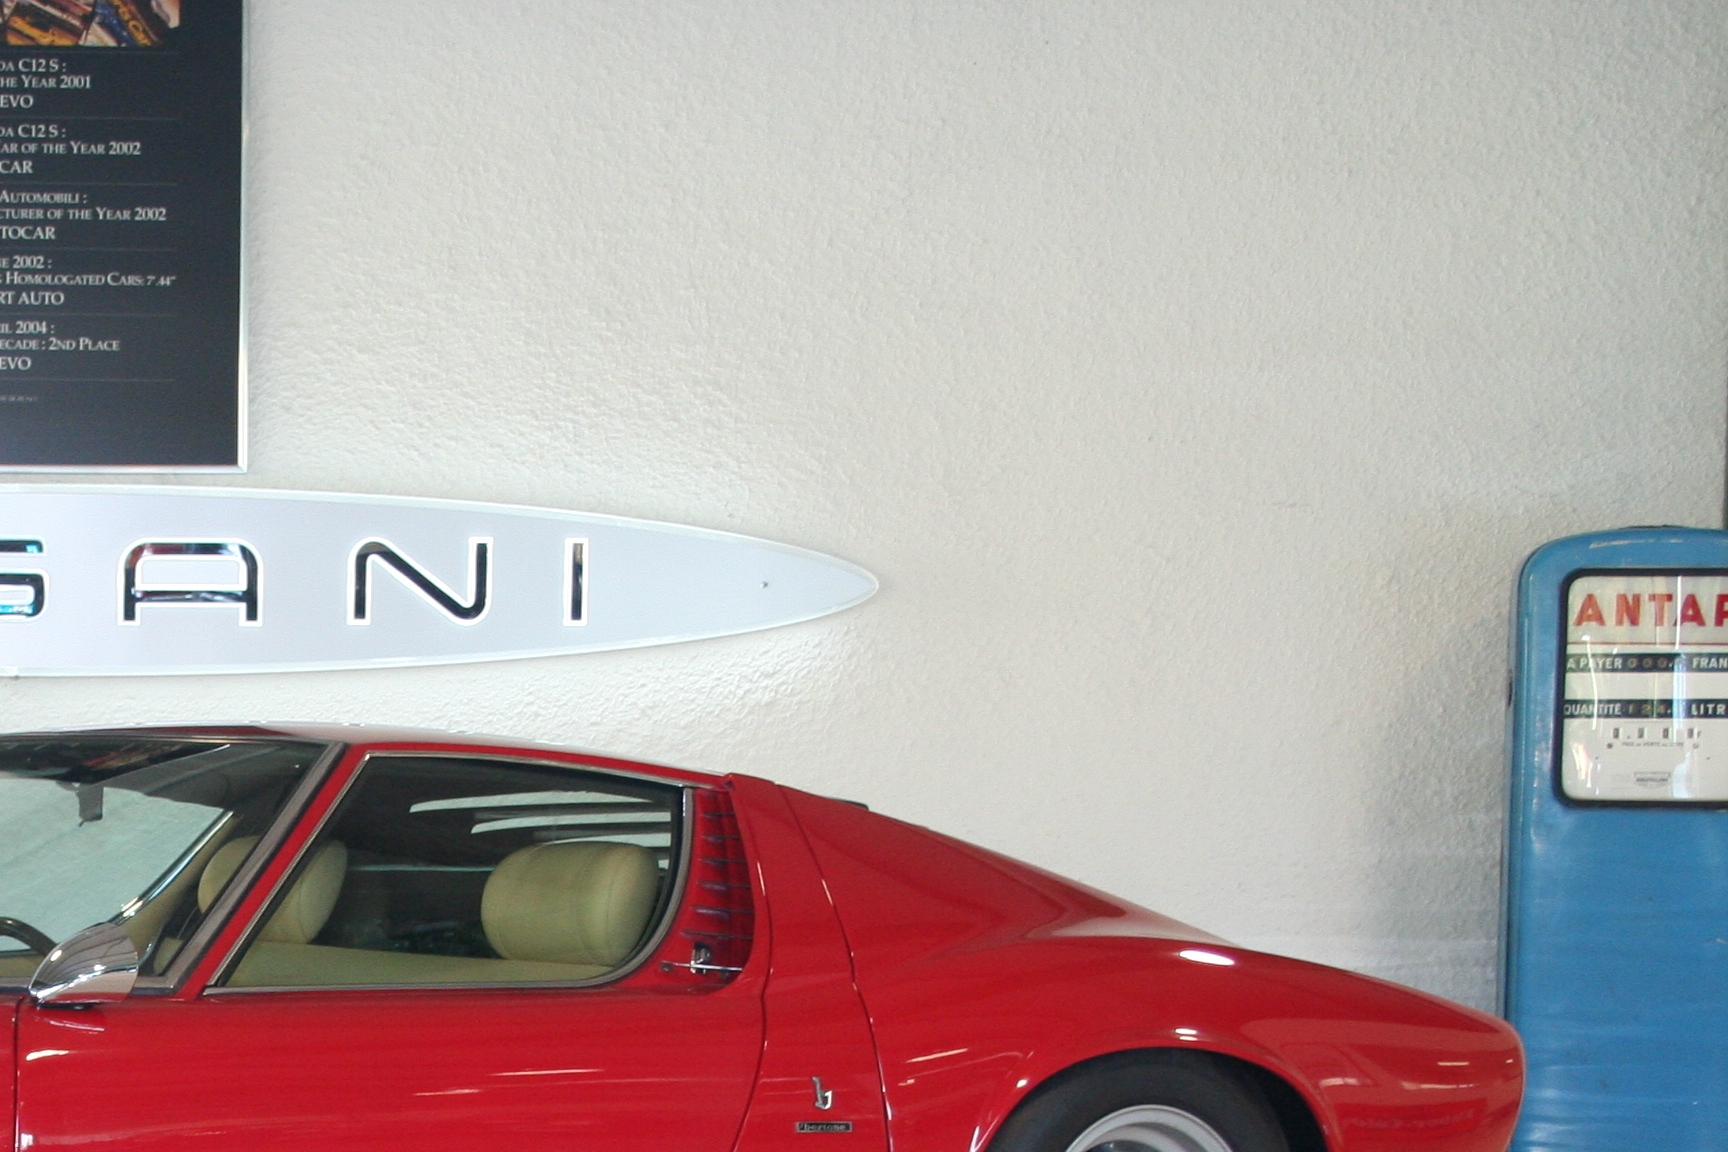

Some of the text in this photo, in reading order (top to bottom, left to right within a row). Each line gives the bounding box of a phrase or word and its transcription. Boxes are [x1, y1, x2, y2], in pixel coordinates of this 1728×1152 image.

[18, 58, 46, 72] C12
[21, 73, 57, 88] YEAR
[59, 74, 91, 89] 2001
[0, 94, 34, 108] EVO
[17, 124, 46, 138] C12
[20, 142, 38, 154] OF
[42, 143, 66, 154] THE
[69, 140, 105, 155] YEAR
[108, 141, 141, 156] 2002
[46, 208, 64, 220] OF
[67, 208, 92, 220] THE
[95, 206, 131, 220] YEAR
[134, 207, 167, 221] 2002
[12, 254, 45, 269] 2002
[5, 270, 106, 286] HOMOLOGATED
[18, 291, 65, 306] AUTO
[15, 320, 47, 334] 2004
[48, 336, 77, 351] 2ND
[79, 336, 119, 351] PLACE
